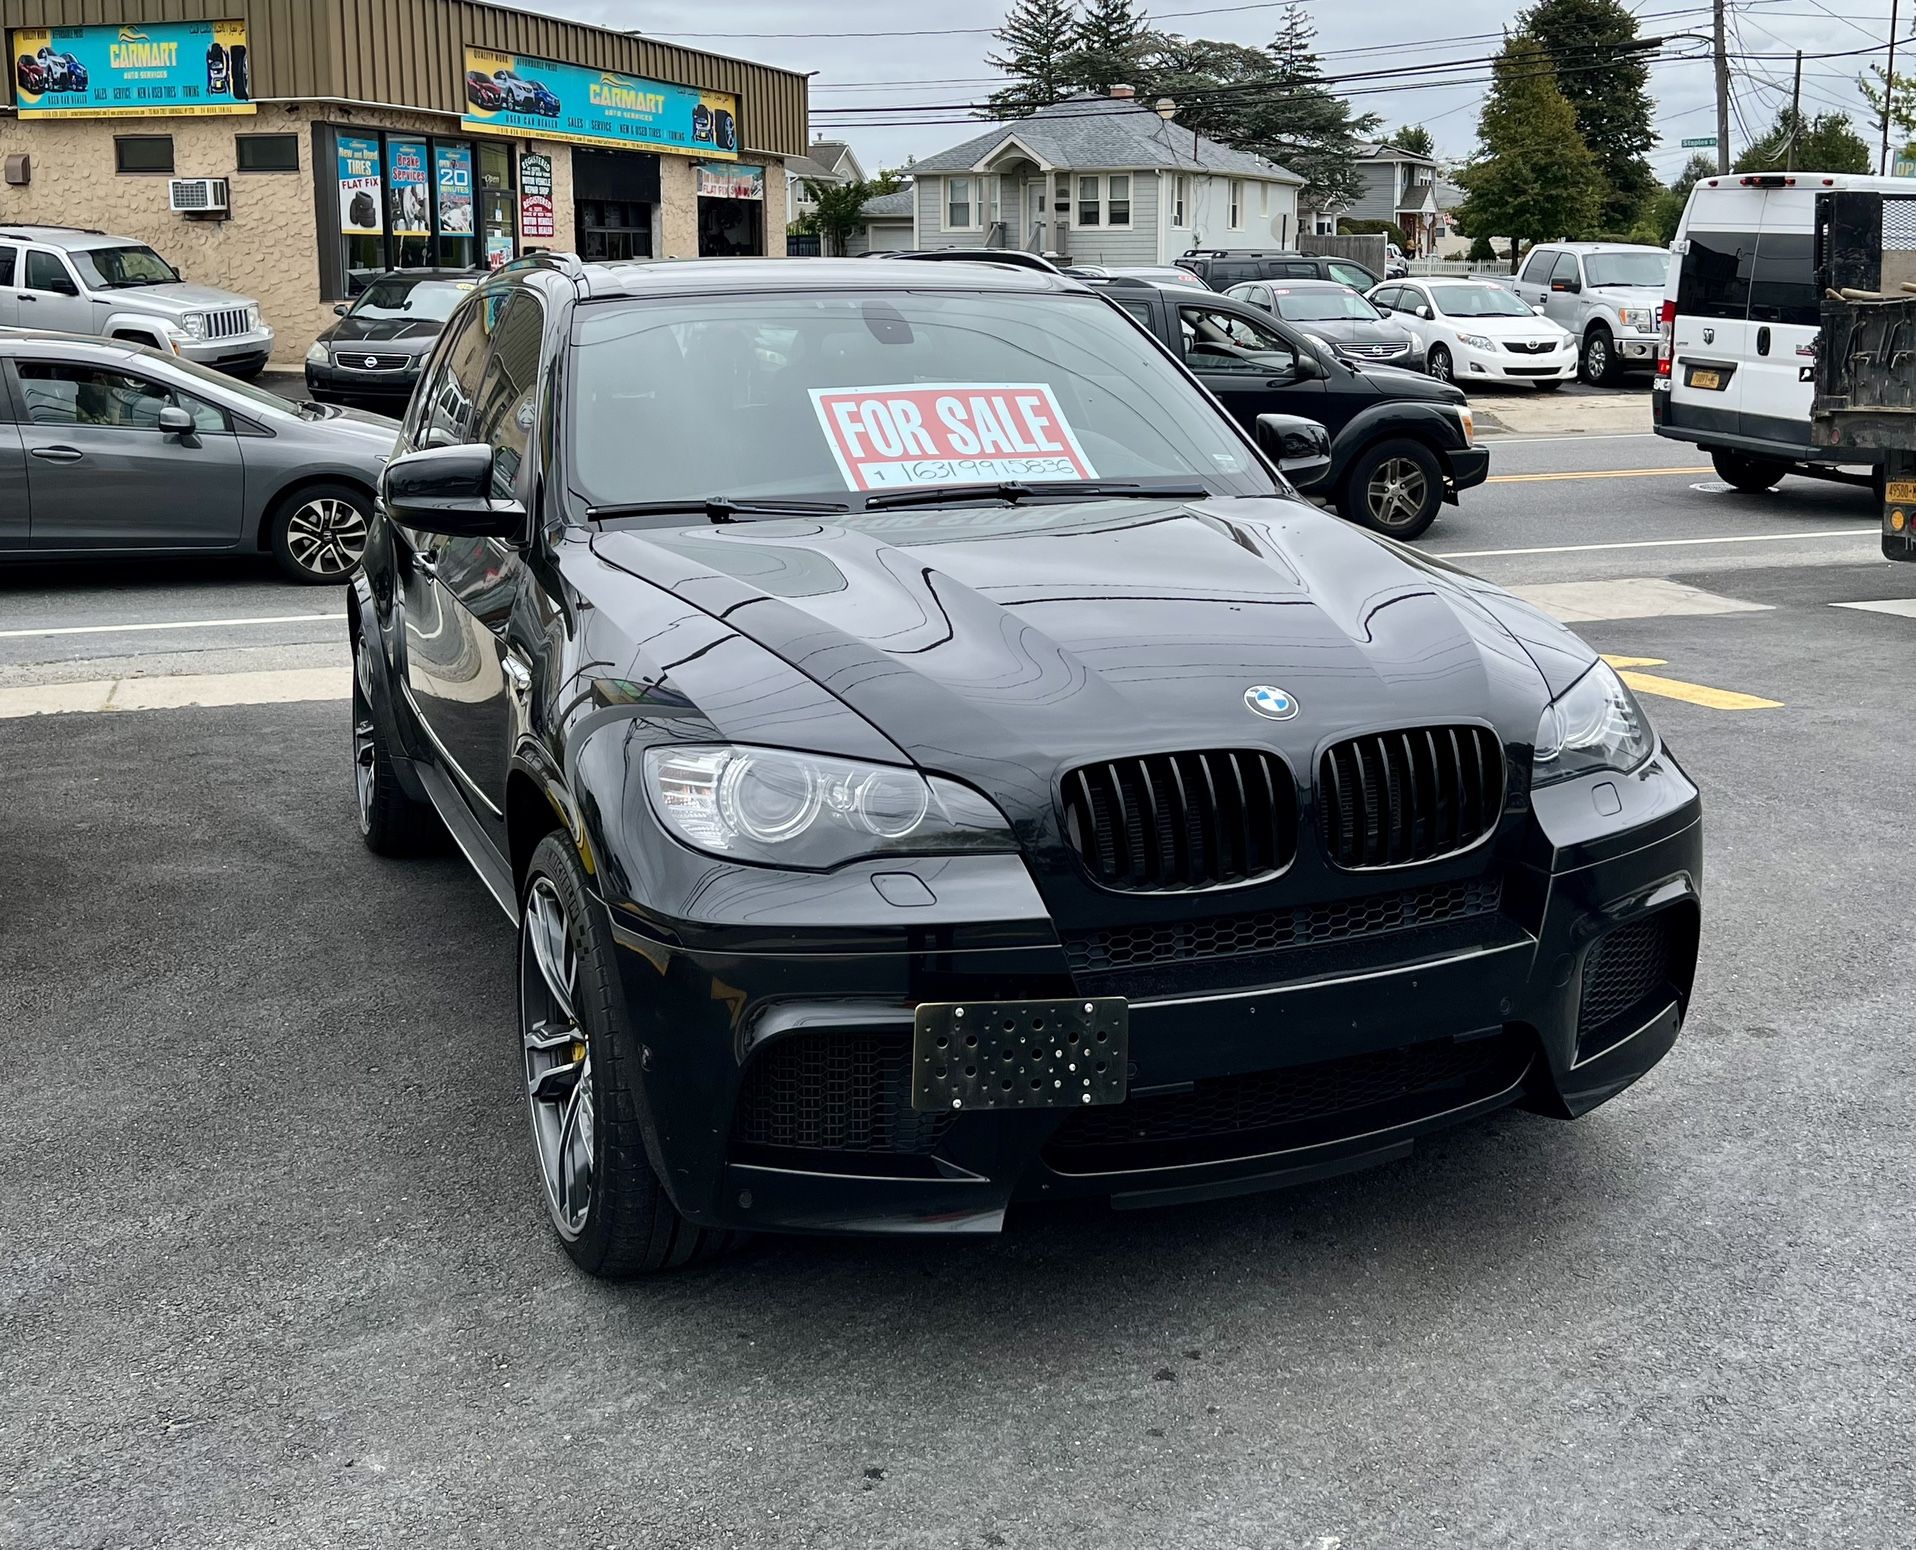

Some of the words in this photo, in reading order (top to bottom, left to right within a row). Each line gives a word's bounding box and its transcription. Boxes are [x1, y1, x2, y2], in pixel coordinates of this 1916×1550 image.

[110, 42, 178, 69] CARMART
[473, 49, 494, 60] QUALITY
[495, 53, 508, 63] WORK
[47, 95, 59, 105] USED
[61, 95, 70, 104] CAR
[71, 94, 88, 104] DEALER
[94, 88, 107, 100] SALES
[113, 87, 131, 99] SERVICE
[137, 87, 146, 99] NEW
[151, 86, 163, 98] USED
[163, 86, 176, 98] TIRES
[182, 85, 200, 98] TOWING
[590, 83, 665, 114] CARMART
[506, 114, 521, 124] USED
[524, 116, 535, 126] CAR
[538, 118, 558, 128] DEALER
[605, 109, 622, 117] AUTO
[623, 111, 653, 122] SERVICES
[568, 117, 583, 129] SALES
[591, 120, 612, 133] SERVICE
[620, 123, 630, 134] NEW
[635, 125, 648, 136] USED
[648, 127, 661, 138] TIRES
[667, 130, 685, 141] TOWING
[346, 159, 372, 176] TIRES
[397, 153, 420, 168] Brake
[521, 155, 551, 172] REGISTERED
[392, 166, 425, 183] Services
[1896, 161, 1916, 177] OP
[342, 179, 363, 189] FLAT
[365, 177, 379, 187] FIX
[440, 169, 468, 186] 20
[440, 185, 469, 194] MINUTES
[490, 252, 504, 265] WE
[831, 399, 940, 458] FOR
[935, 395, 1064, 455] SALE
[545, 849, 581, 925] MICHELIN
